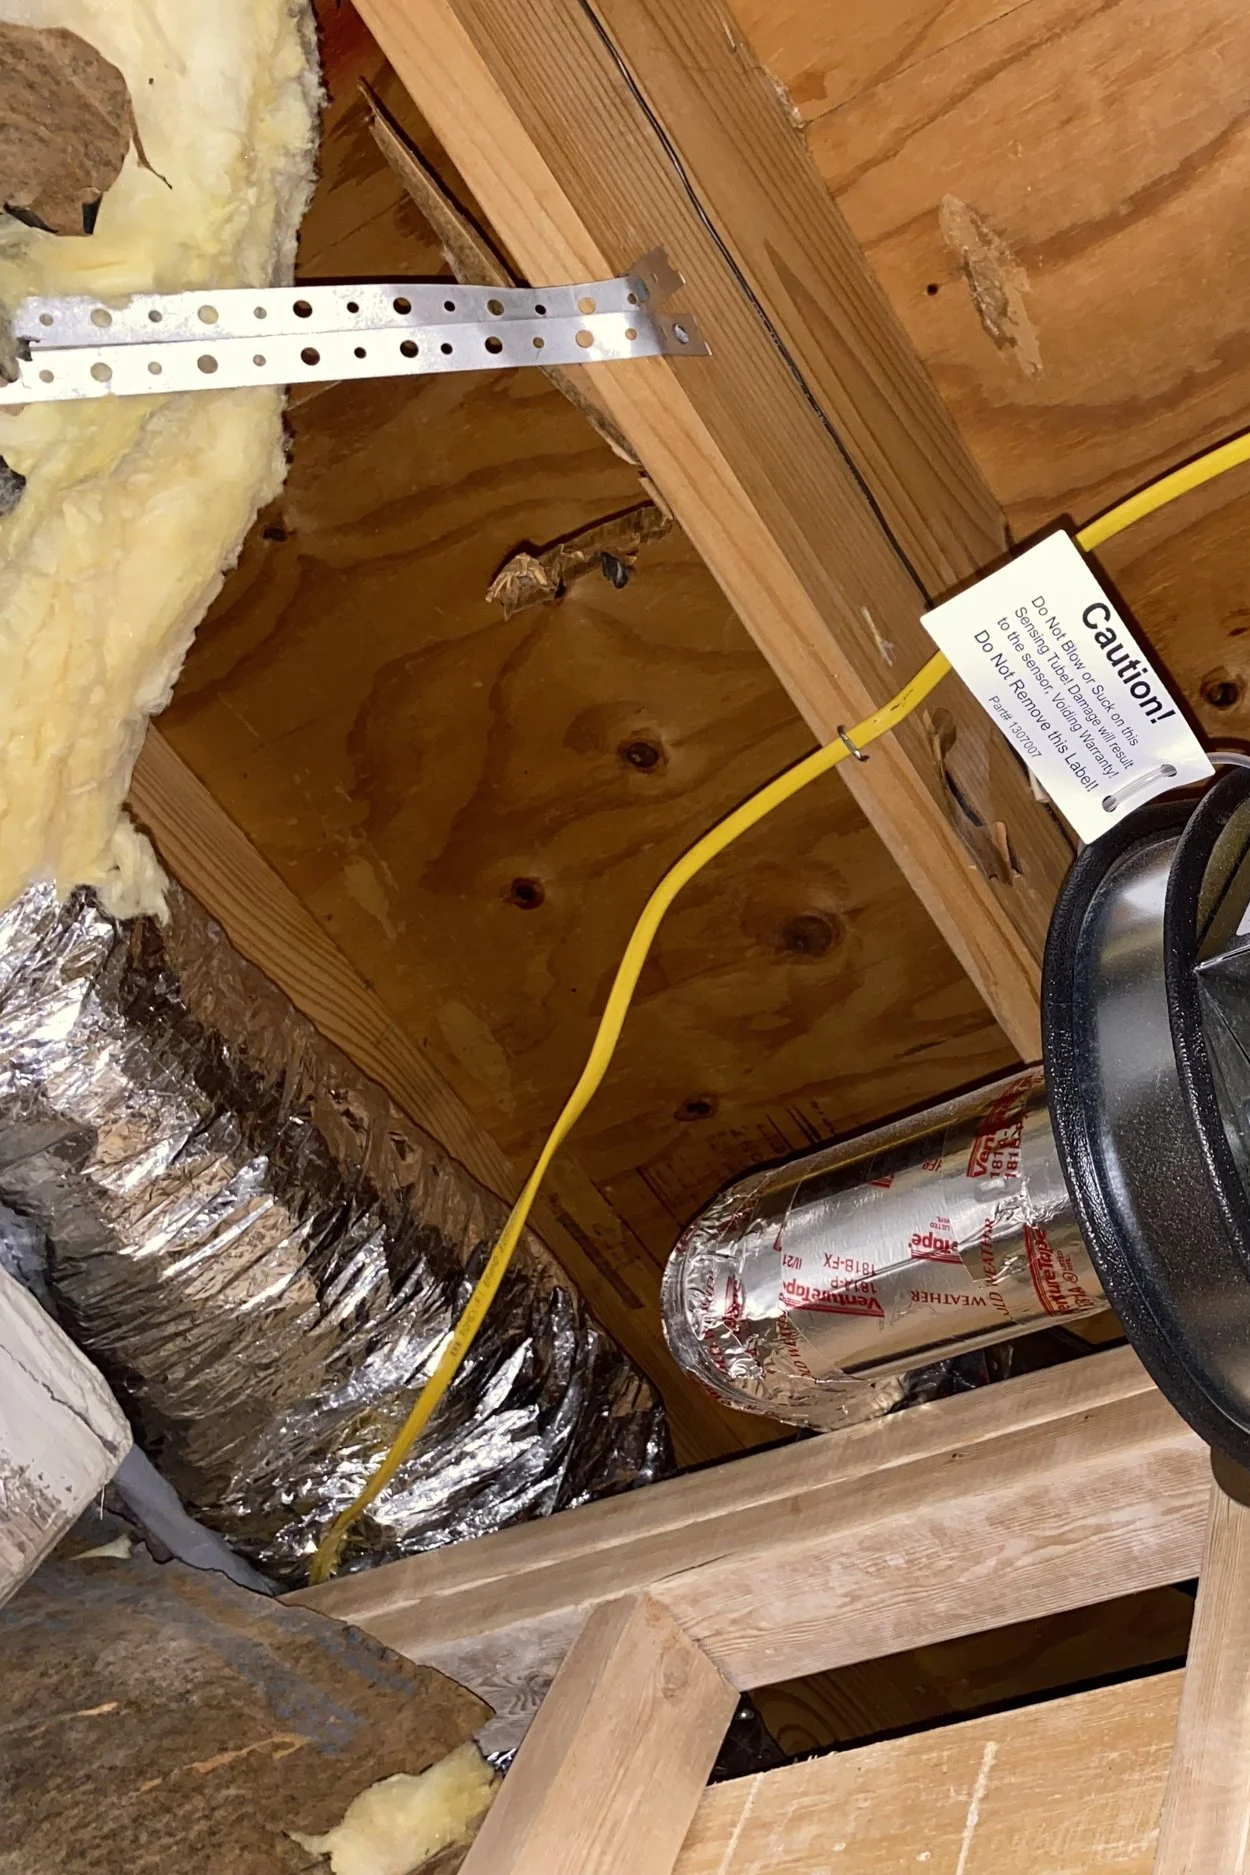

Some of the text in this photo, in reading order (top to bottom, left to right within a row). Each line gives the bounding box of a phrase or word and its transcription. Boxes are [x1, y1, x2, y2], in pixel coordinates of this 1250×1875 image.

[974, 629, 1099, 793] Do Not Remove this Label!
[988, 695, 1042, 758] Part# 1307007
[997, 616, 1120, 780] to the sensor, Voiding Warranty!
[1014, 606, 1135, 770] Sensing Tube! Damage will result
[1031, 595, 1139, 747] Do Not Blow or Suck on this
[1082, 602, 1176, 725] Caution!
[910, 1289, 987, 1307] WEATHER
